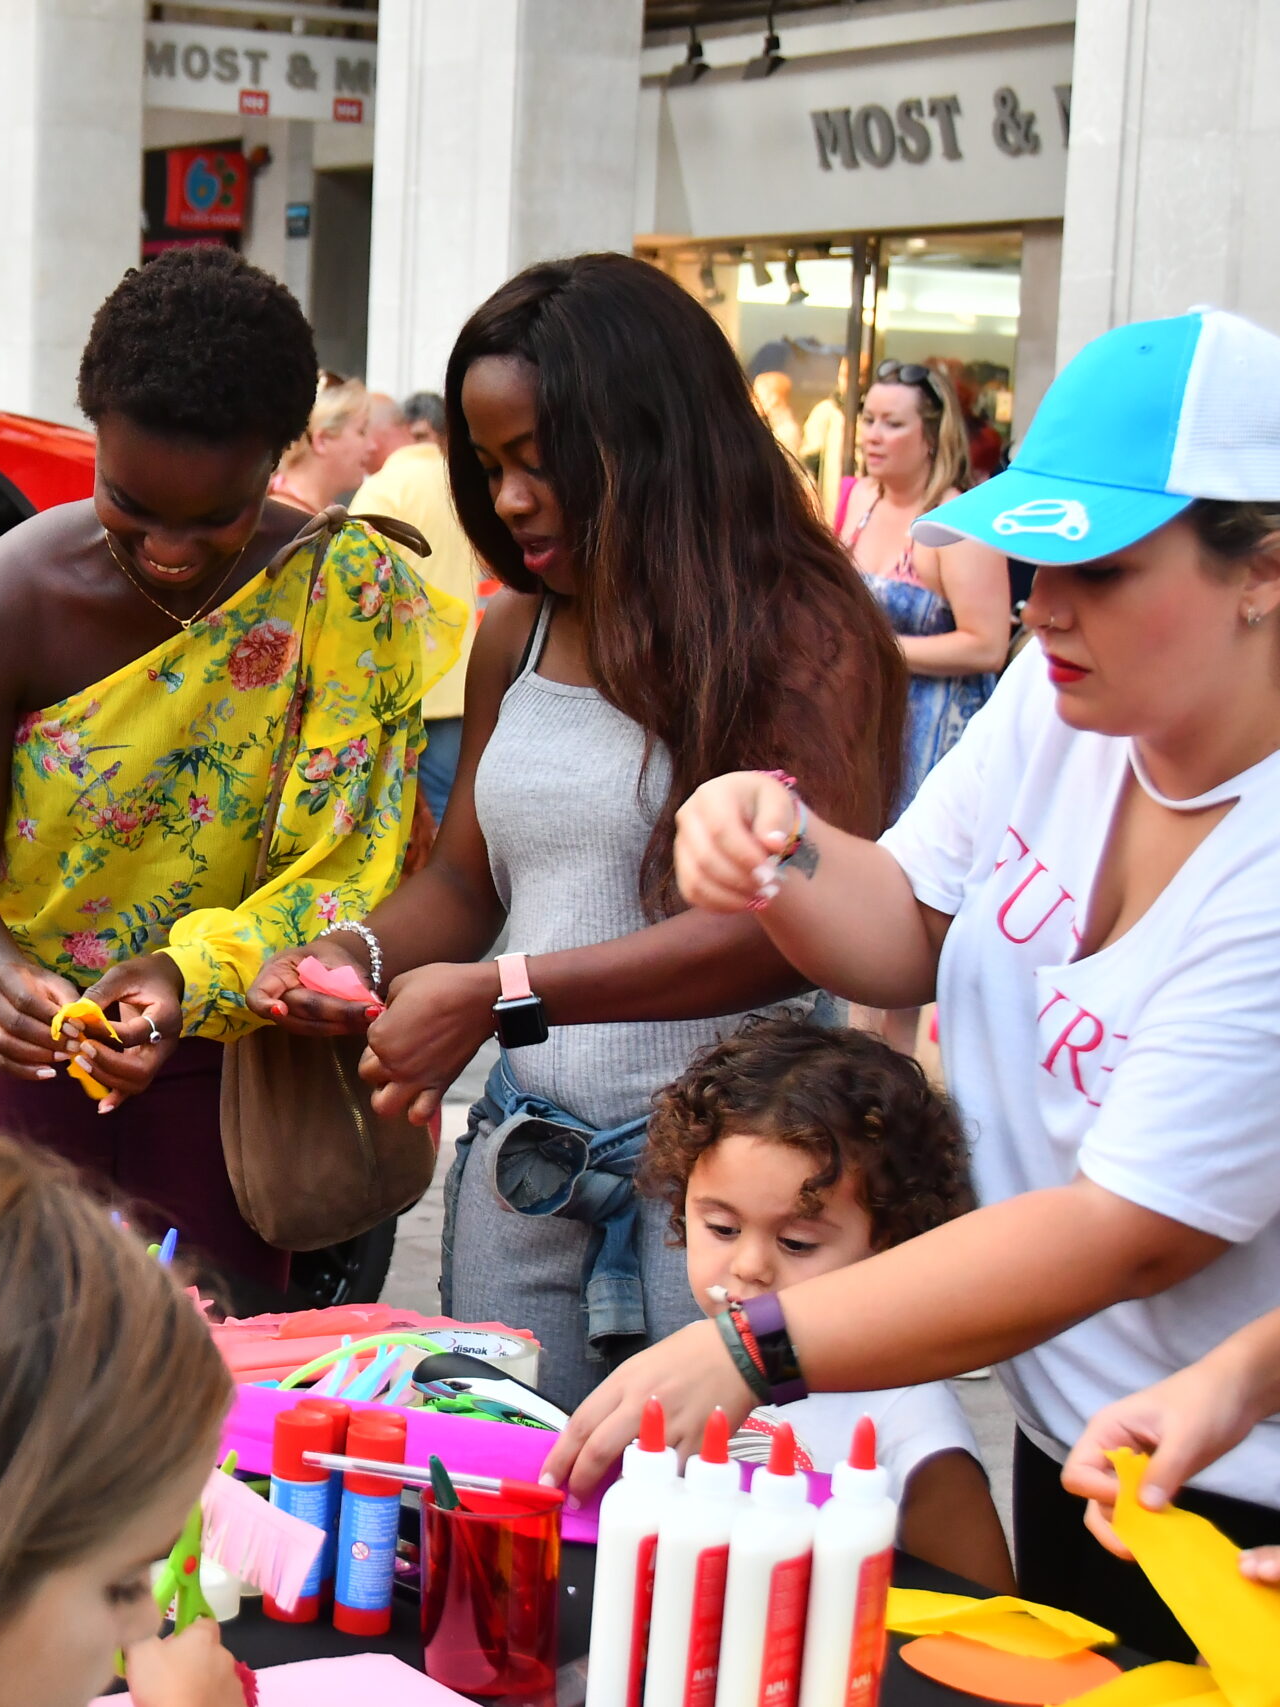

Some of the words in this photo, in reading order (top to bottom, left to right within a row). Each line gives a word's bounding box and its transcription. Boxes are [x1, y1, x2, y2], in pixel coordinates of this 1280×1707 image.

[145, 40, 269, 85] MOST
[286, 53, 318, 91] &
[810, 94, 964, 172] MOST
[992, 86, 1042, 158] &
[452, 1345, 488, 1356] disnak
